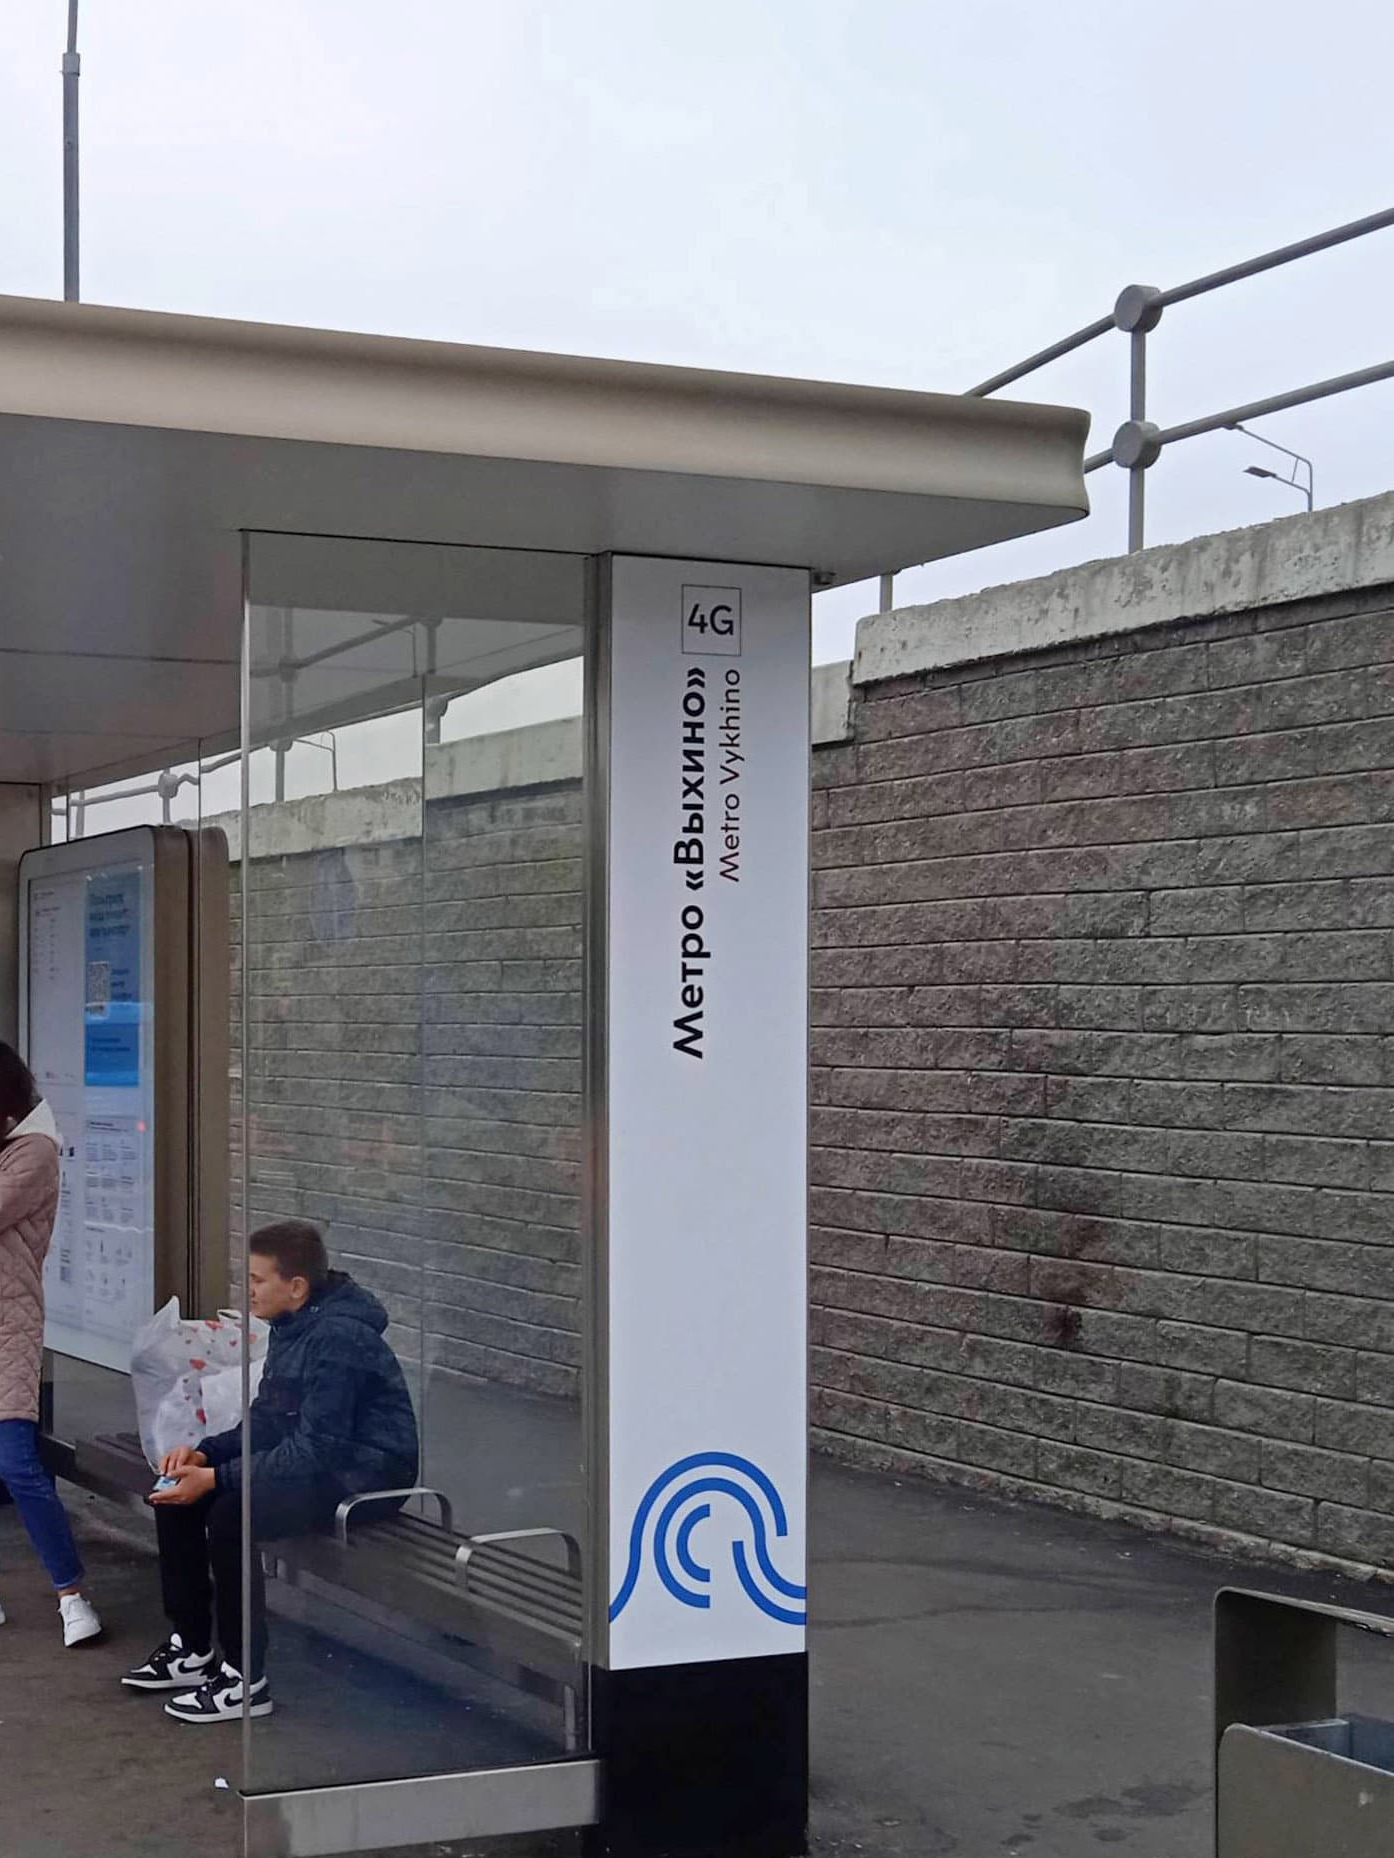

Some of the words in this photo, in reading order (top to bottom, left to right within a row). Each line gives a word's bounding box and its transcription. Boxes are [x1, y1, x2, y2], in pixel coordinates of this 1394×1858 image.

[687, 603, 734, 636] 4G
[673, 667, 705, 891] «Выхино»
[719, 669, 745, 785] Vykhino
[720, 793, 740, 882] Metro
[673, 905, 711, 1059] Метро
